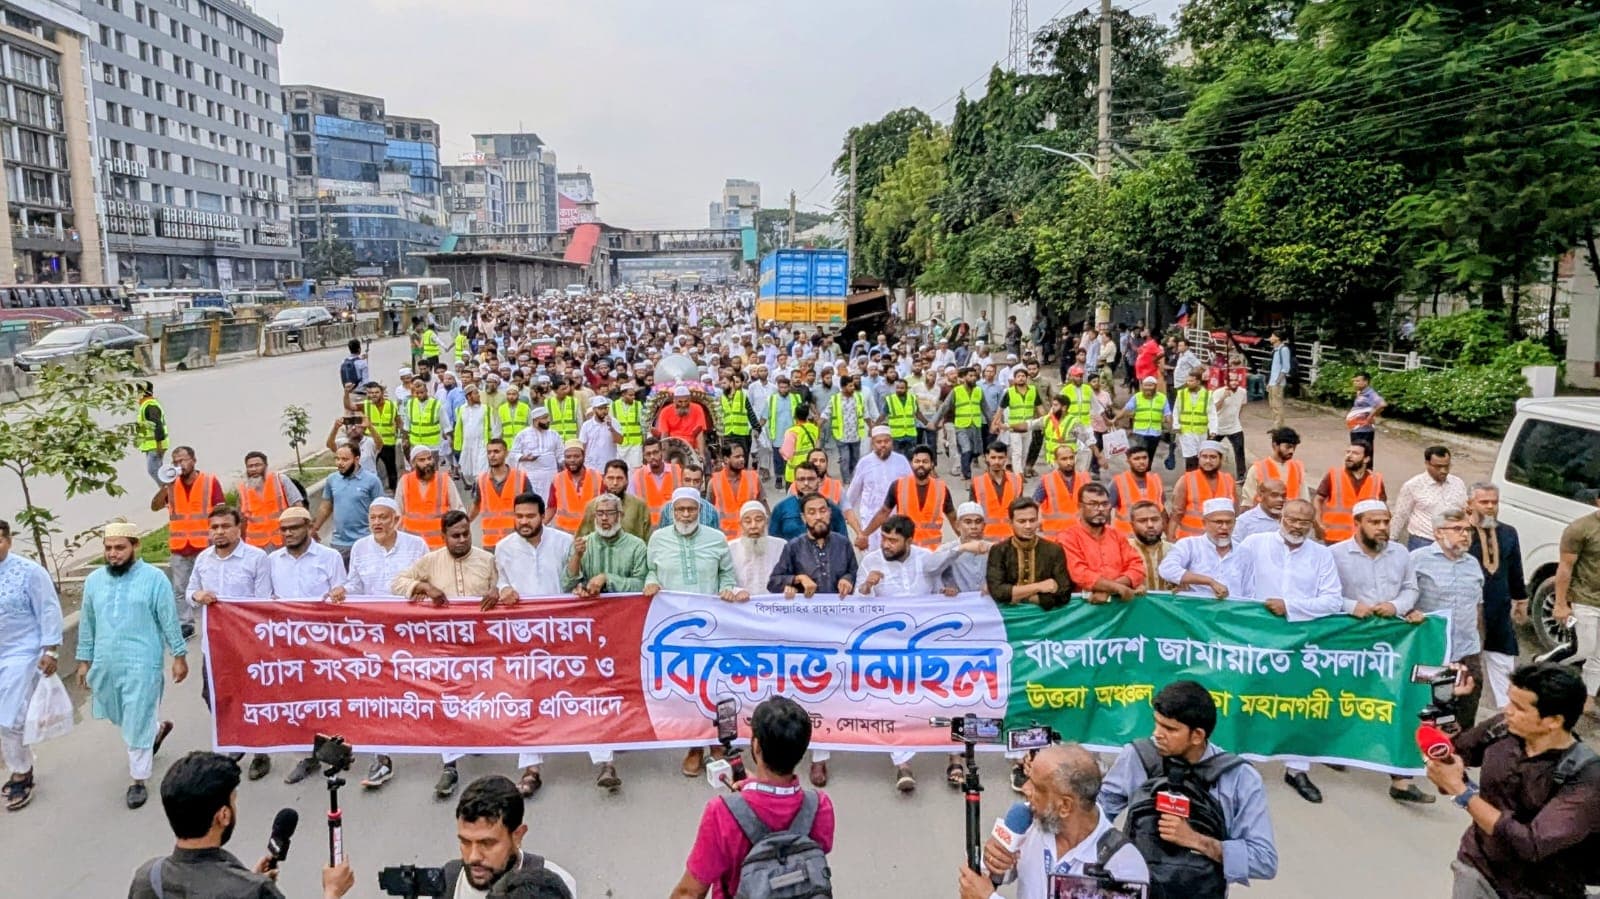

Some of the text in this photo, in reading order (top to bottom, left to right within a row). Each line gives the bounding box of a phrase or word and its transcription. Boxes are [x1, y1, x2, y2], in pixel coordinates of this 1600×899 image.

[254, 617, 385, 648] গণভোটের
[394, 621, 476, 643] গণরায়
[247, 649, 616, 686] গ্যাস সংকট নিরসনের দাবিতে ও
[648, 618, 1004, 716] বিক্ষোভ মিছিল
[1023, 634, 1401, 678] বাংলাদেশ জামায়াতে ইসলামী
[242, 699, 343, 727] দ্রব্যমূল্যের
[346, 691, 437, 721] লাগামহীন
[538, 690, 625, 719] প্রতিবাদে
[1026, 681, 1089, 709] উত্তরা
[1094, 684, 1155, 708] অঞ্চল
[1239, 689, 1334, 721] মহানগরী
[1340, 691, 1396, 725] উত্তর
[836, 716, 895, 734] সোমবার
